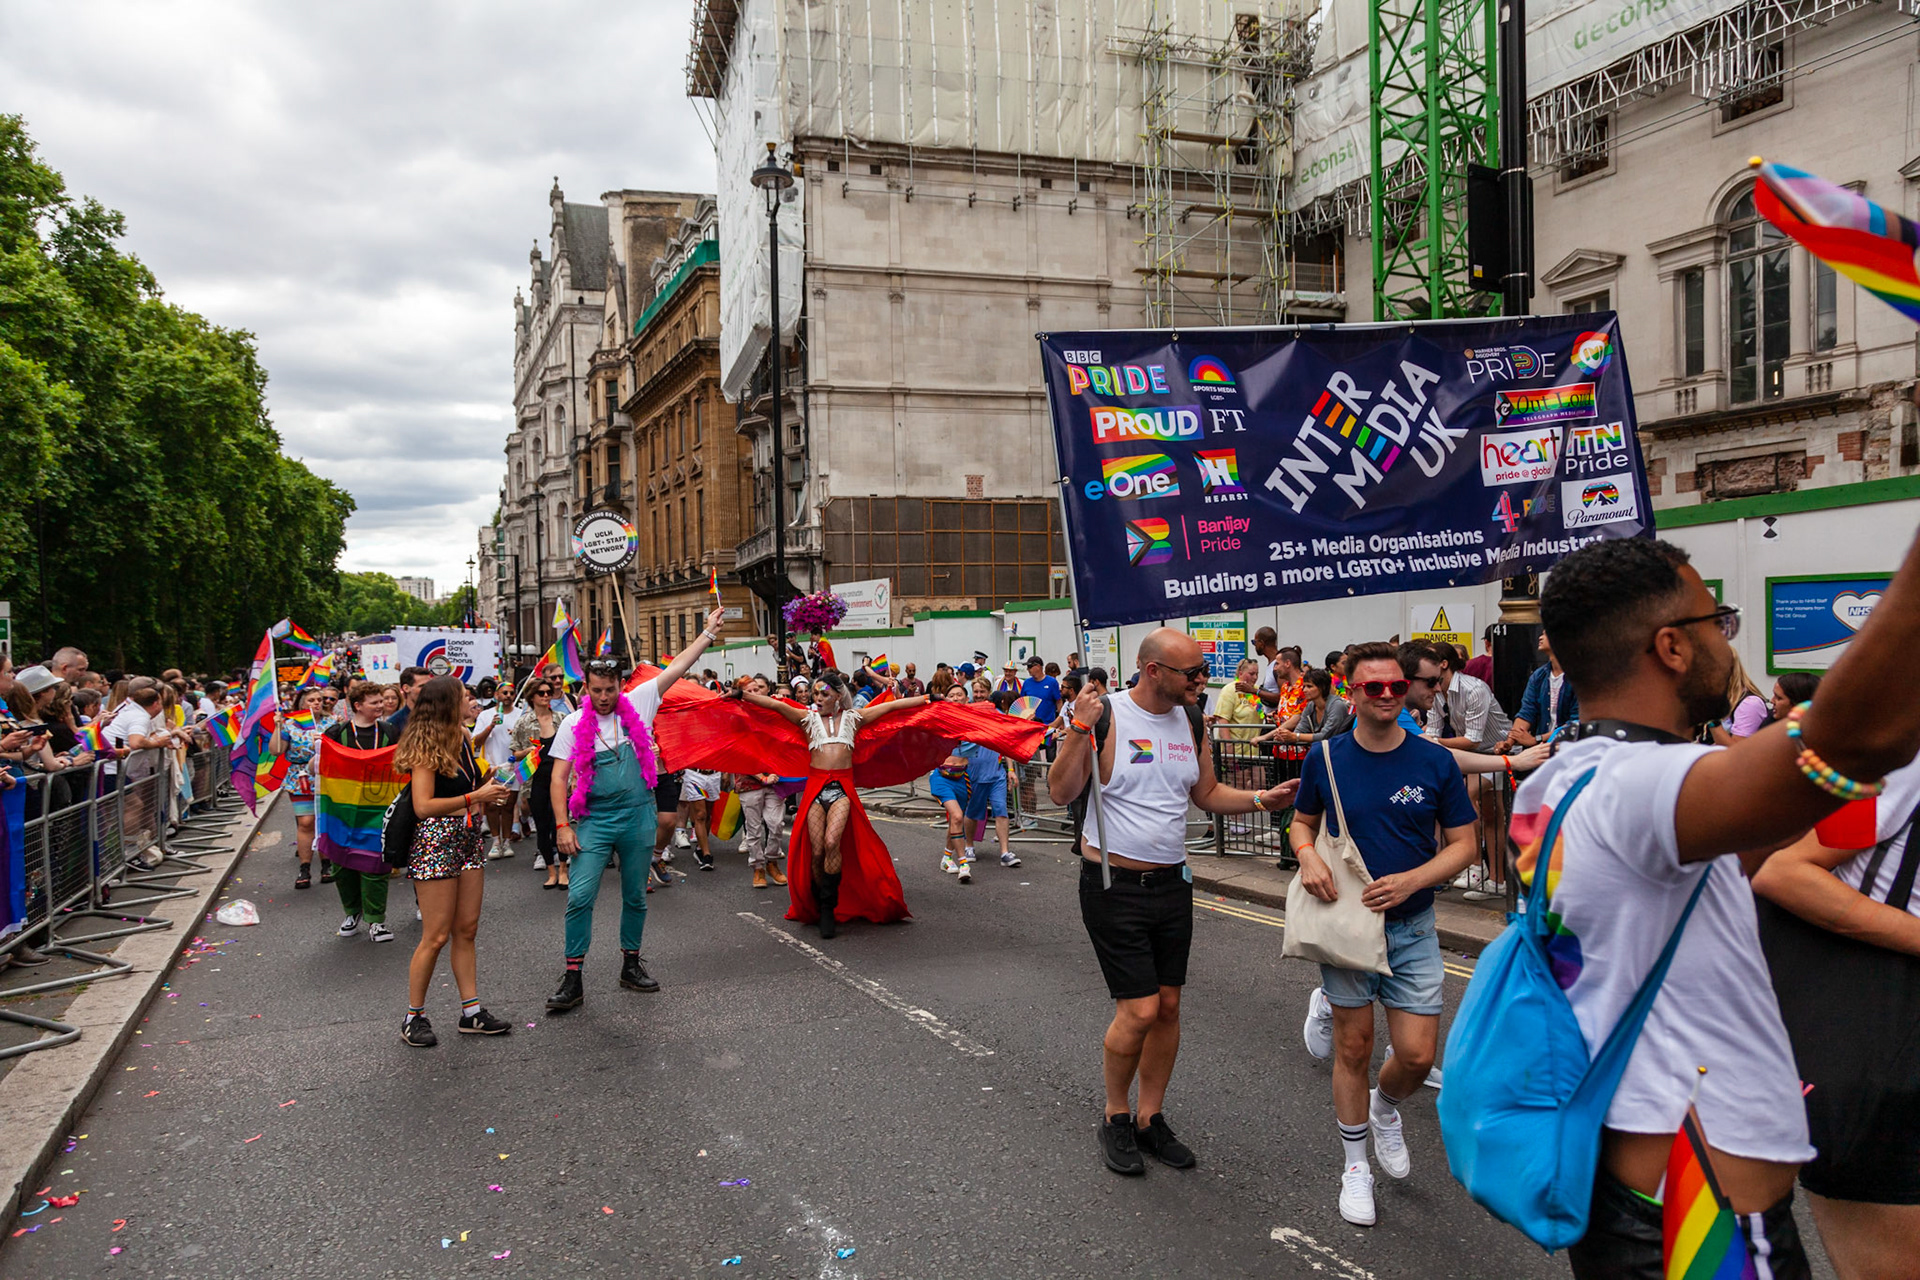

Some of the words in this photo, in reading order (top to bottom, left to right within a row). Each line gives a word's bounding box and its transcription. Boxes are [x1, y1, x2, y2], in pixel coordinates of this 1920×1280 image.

[1065, 351, 1101, 363] BBC
[1466, 345, 1556, 384] PRIDE
[1066, 364, 1170, 396] PRIDE
[1517, 394, 1552, 415] Out
[1095, 410, 1199, 438] PROUD
[1208, 408, 1246, 433] FT
[1523, 412, 1559, 422] TELEGRAPH
[1264, 370, 1372, 514] INTER
[1332, 360, 1441, 510] MEDIA
[1409, 406, 1469, 478] UK
[1565, 421, 1627, 457] ITN
[1483, 429, 1560, 469] heart
[1565, 452, 1629, 475] Pride
[1495, 468, 1520, 483] pride
[1522, 470, 1530, 478] @
[1084, 471, 1171, 501] eOne
[1204, 493, 1249, 504] HEARST
[1198, 516, 1250, 534] Banijay
[1565, 506, 1634, 528] Paramount
[590, 544, 624, 554] NETWORK
[606, 536, 627, 544] STAFF
[1200, 536, 1241, 553] Pride
[1268, 541, 1308, 562] 25+
[1311, 536, 1366, 557] Media
[1368, 529, 1484, 555] Organisations
[617, 560, 628, 568] THE
[1164, 572, 1258, 599] Building
[1263, 571, 1277, 587] a
[1281, 565, 1335, 585] more
[1337, 556, 1406, 580] LGBTQ+
[1408, 551, 1482, 574] inclusive
[1484, 543, 1520, 566] Media
[1849, 607, 1872, 616] NHS
[1424, 633, 1458, 643] DANGER
[1493, 624, 1507, 636] 41
[372, 654, 389, 671] BI
[1167, 742, 1193, 754] Banijay
[1168, 753, 1188, 762] Pride
